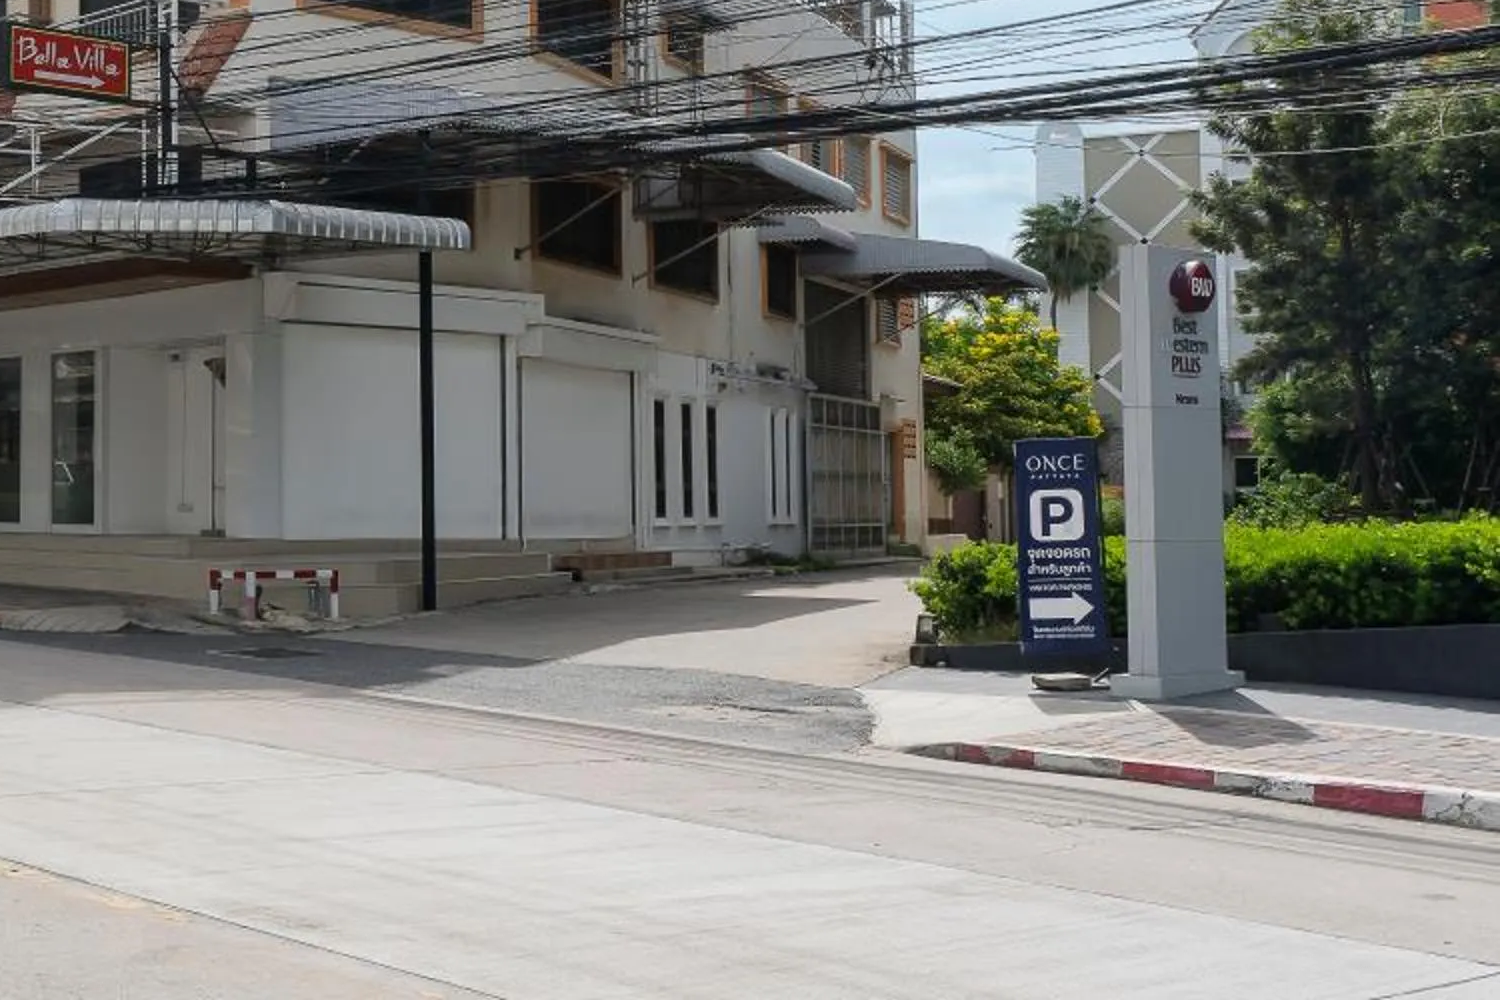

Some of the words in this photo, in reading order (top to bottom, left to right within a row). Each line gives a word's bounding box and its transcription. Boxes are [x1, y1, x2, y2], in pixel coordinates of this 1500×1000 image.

[16, 35, 72, 69] Bella
[73, 43, 121, 76] Villa
[1171, 355, 1202, 373] PLUS
[1025, 453, 1086, 472] ONCE
[1040, 496, 1074, 536] P
